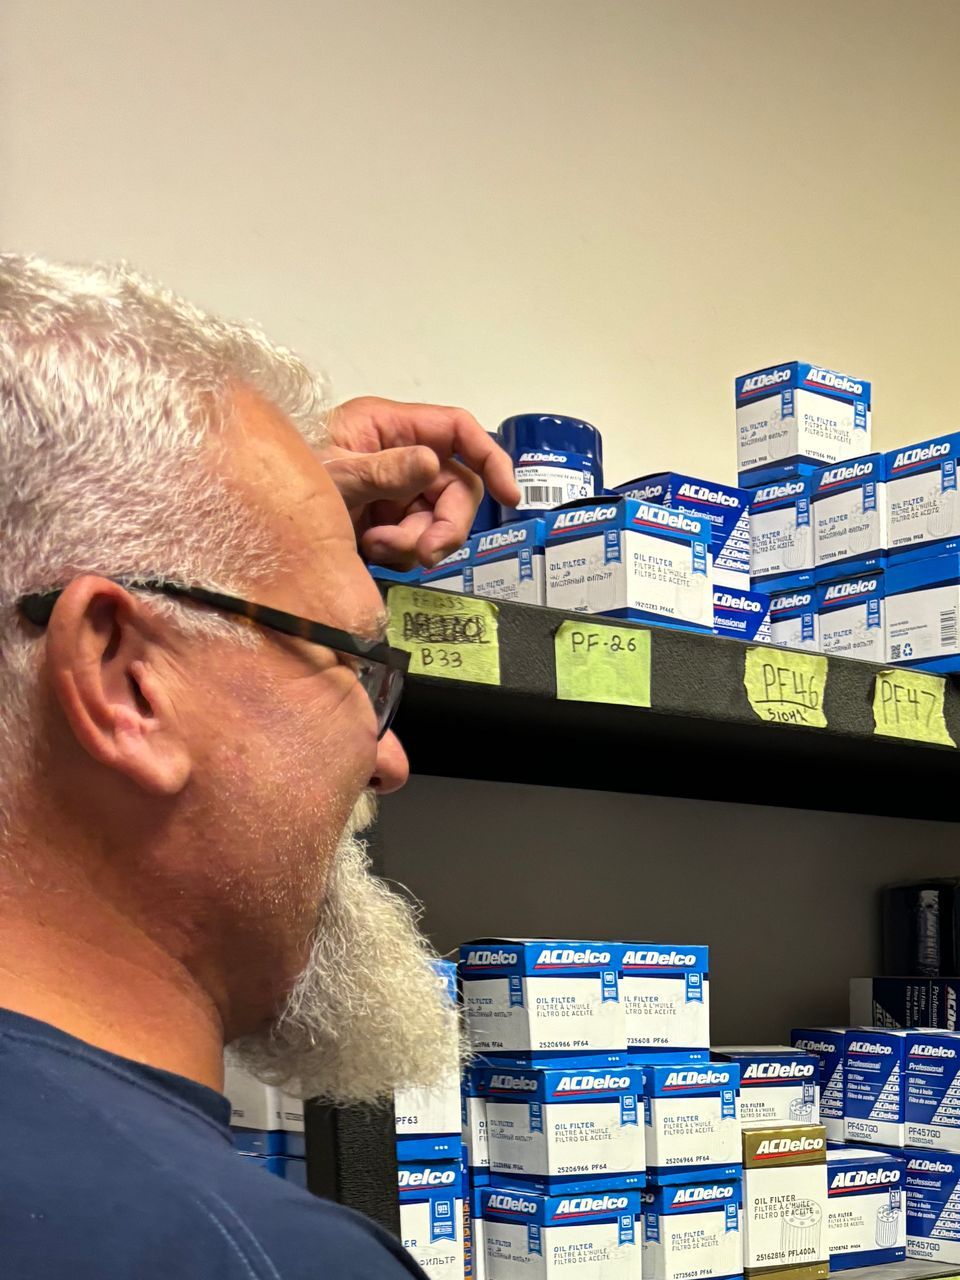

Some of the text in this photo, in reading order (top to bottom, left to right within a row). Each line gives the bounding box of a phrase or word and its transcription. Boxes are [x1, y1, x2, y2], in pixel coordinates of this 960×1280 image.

[742, 369, 791, 392] ACDelco
[806, 369, 863, 394] ACDelco
[893, 442, 950, 468] ACDelco
[821, 462, 872, 486] ACDelco
[753, 481, 804, 504] ACDelco
[553, 506, 617, 529] ACDelco
[635, 504, 701, 533] ACDelco
[825, 578, 877, 600] ACDelco
[571, 631, 636, 653] PF-26
[762, 664, 818, 707] PF46
[882, 680, 936, 728] PF47
[537, 950, 610, 965] ACDelco
[622, 951, 696, 965] ACDelco
[849, 1041, 892, 1055] ACDelco
[910, 1044, 956, 1058] ACDelco
[743, 1062, 814, 1078] ACDelco
[908, 1062, 944, 1073] Professional
[556, 1075, 631, 1090] ACDelco
[665, 1072, 730, 1085] ACDelco
[396, 1116, 418, 1125] PF63
[756, 1138, 824, 1154] ACDelco
[831, 1169, 900, 1188] ACDelco
[906, 1177, 942, 1186] Professional
[673, 1186, 733, 1203] ACDelco
[770, 1194, 796, 1202] FILTER
[556, 1197, 628, 1214] ACDelco
[756, 1251, 786, 1261] 25162816
